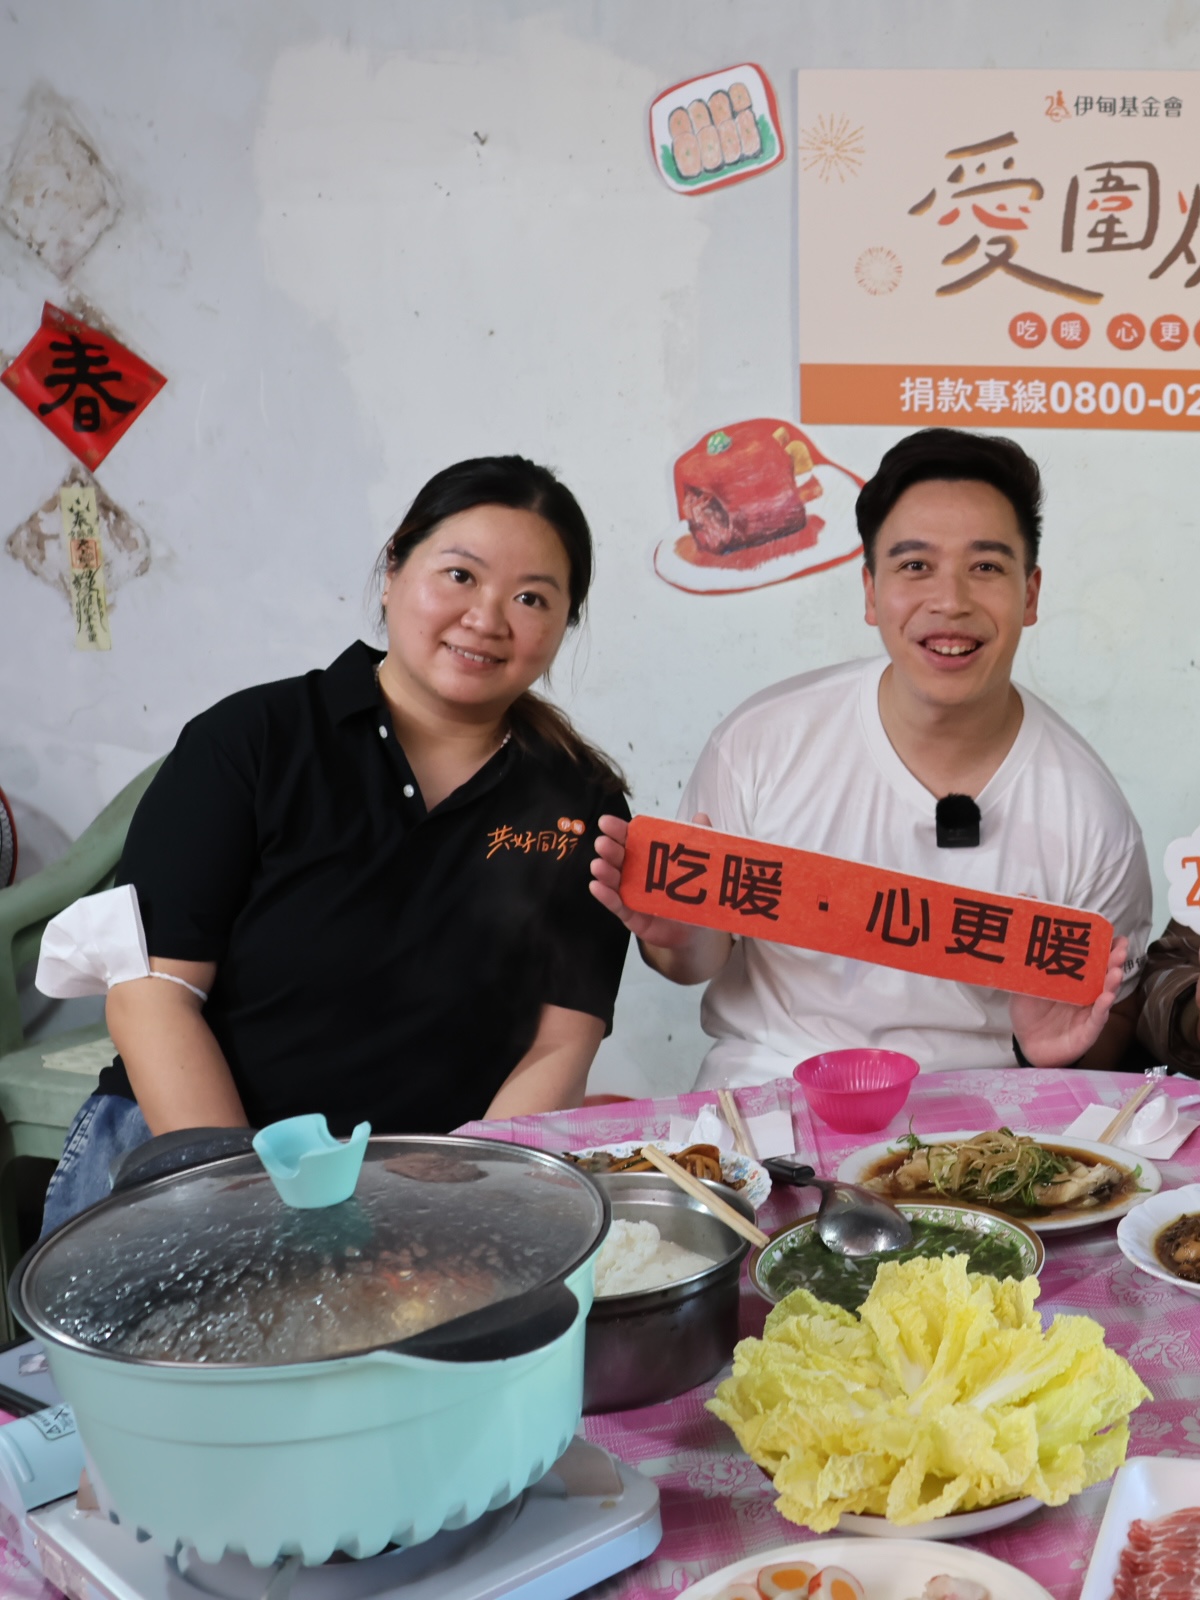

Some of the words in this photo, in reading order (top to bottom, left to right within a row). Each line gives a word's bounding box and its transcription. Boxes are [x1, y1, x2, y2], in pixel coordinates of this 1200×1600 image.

[1073, 95, 1183, 118] 伊甸基金會
[1014, 318, 1083, 344] 吃暖
[38, 334, 137, 433] 春
[486, 824, 579, 861] 共好同行
